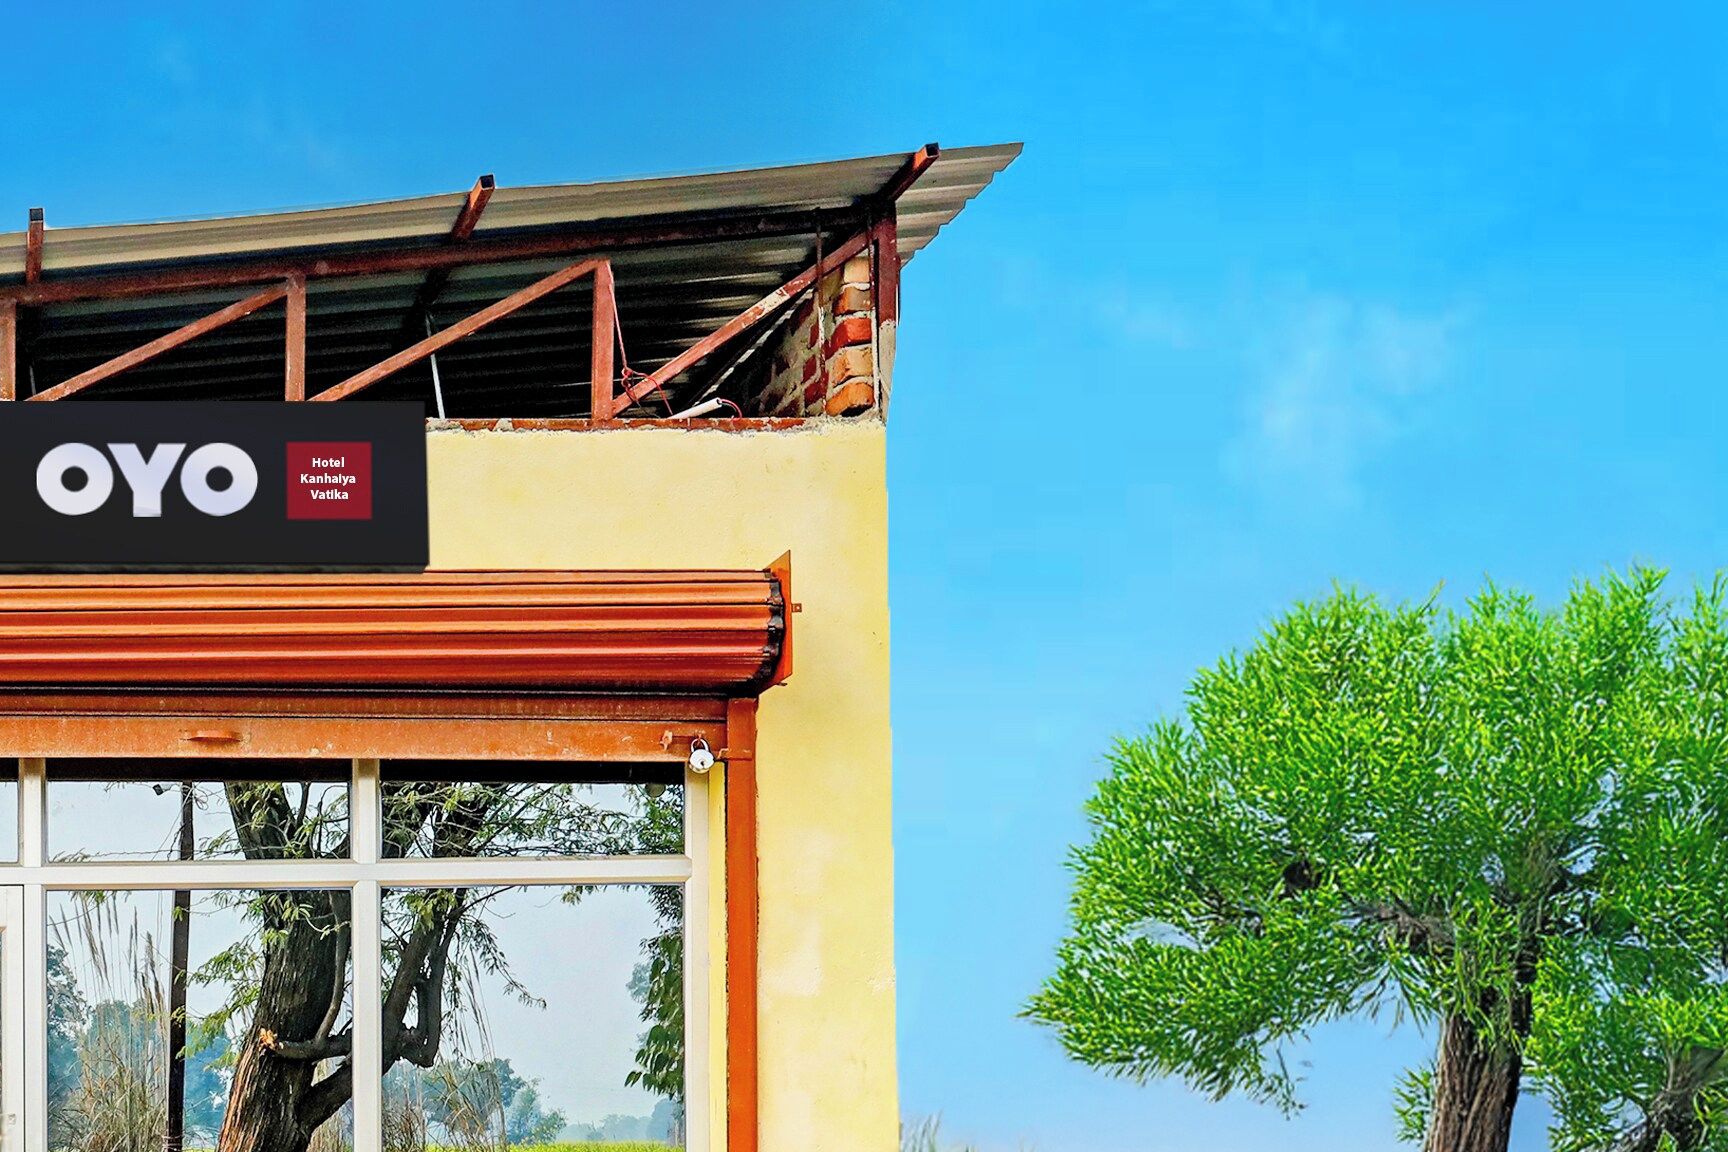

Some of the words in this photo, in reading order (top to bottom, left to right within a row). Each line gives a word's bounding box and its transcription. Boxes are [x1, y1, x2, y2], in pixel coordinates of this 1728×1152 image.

[312, 457, 345, 468] Hotel
[36, 442, 258, 517] OYO
[300, 473, 356, 487] Kanhaiya
[310, 489, 349, 500] Vatika
